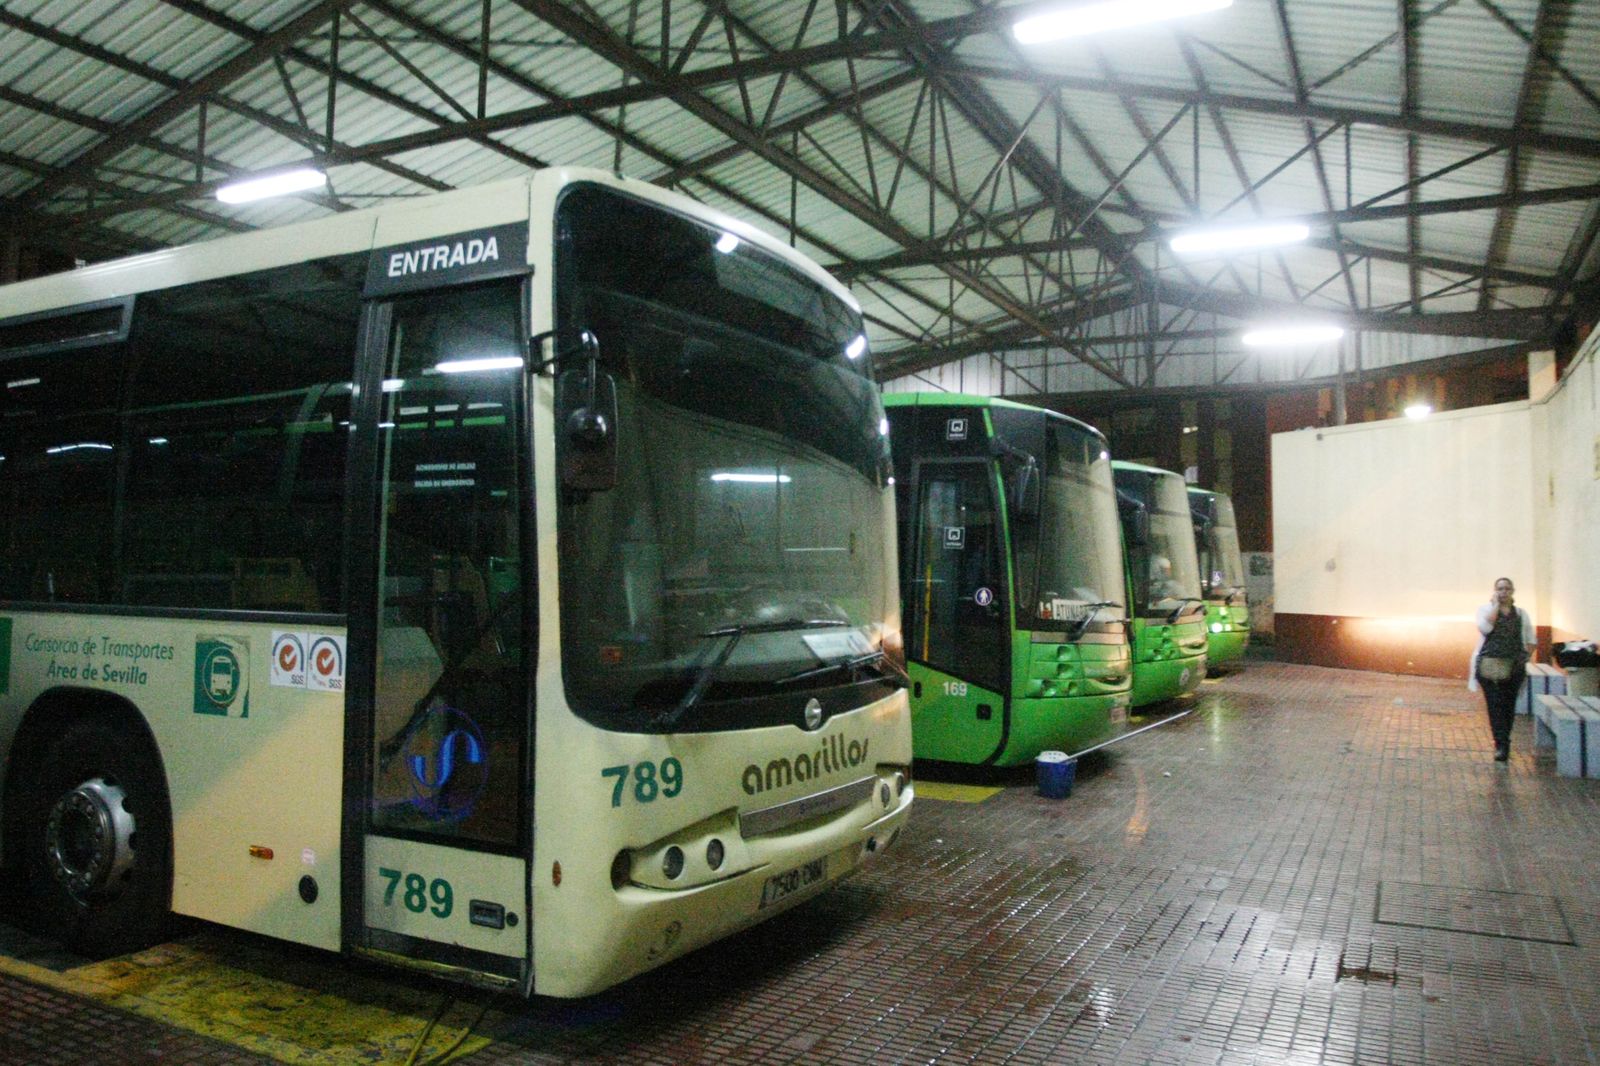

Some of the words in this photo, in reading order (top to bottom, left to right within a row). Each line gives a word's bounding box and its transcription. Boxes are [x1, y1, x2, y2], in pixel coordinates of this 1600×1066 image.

[388, 236, 499, 277] ENTRADA
[25, 633, 78, 654] Consorcio
[82, 637, 97, 655] de
[102, 637, 174, 663] Transportes
[82, 663, 98, 680] de
[102, 664, 148, 685] Sevilla
[290, 674, 305, 685] SGS
[328, 678, 343, 689] SGS
[943, 681, 968, 697] 169
[601, 757, 684, 808] 789
[379, 867, 454, 919] 789
